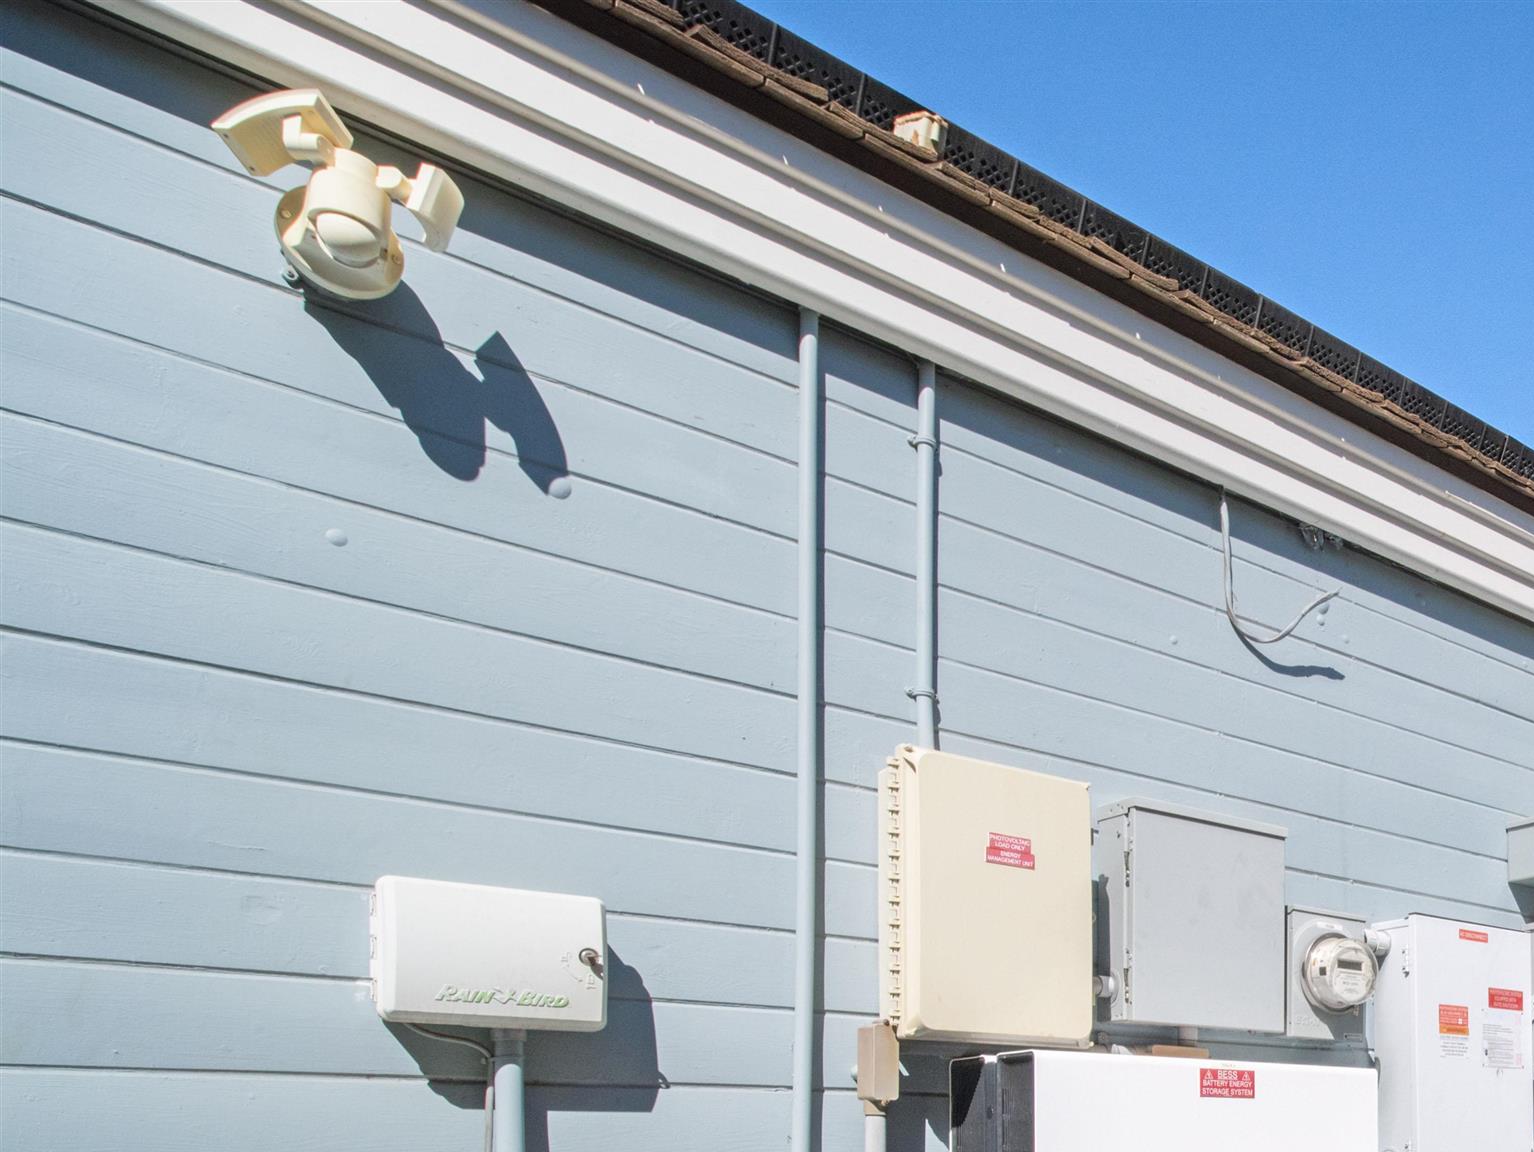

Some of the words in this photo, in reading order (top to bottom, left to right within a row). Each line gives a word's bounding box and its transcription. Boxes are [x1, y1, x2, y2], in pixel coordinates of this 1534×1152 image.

[1000, 850, 1021, 859] ENERGY
[987, 855, 1022, 865] MANAGEMENT
[435, 983, 495, 1004] RAIN
[517, 990, 570, 1008] BIRD
[1217, 1069, 1238, 1080] BESS
[1202, 1079, 1228, 1088] BATTERY
[1229, 1080, 1253, 1089] ENERGY
[1202, 1087, 1230, 1096] STORAGE
[1231, 1088, 1253, 1097] SYSTEM
